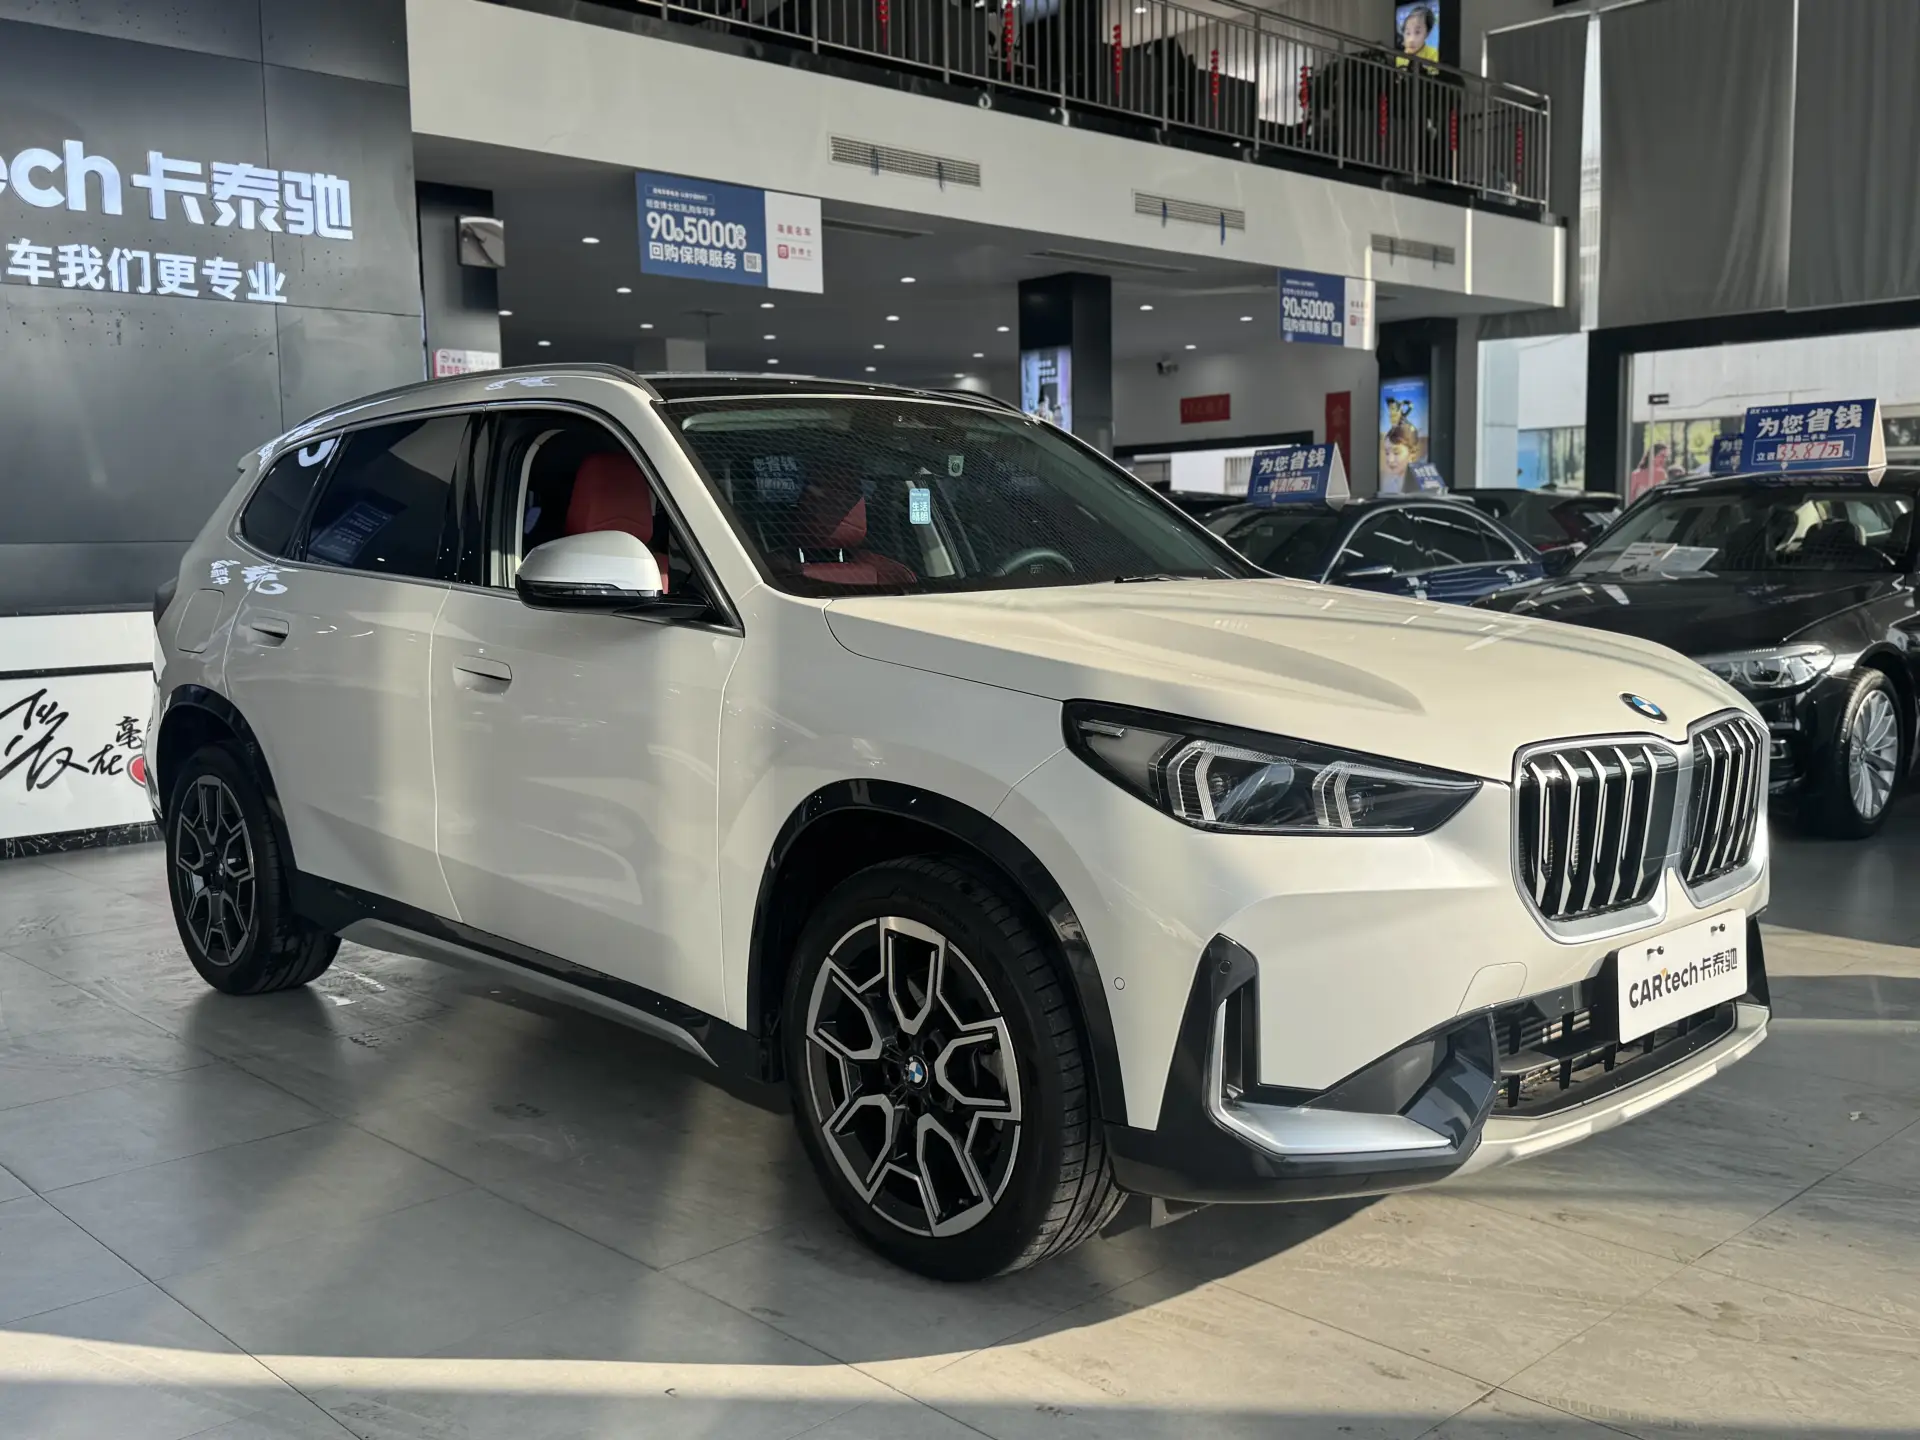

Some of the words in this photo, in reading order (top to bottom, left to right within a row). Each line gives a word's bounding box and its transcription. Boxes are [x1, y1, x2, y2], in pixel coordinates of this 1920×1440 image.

[131, 150, 353, 240] 卡泰驰
[6, 238, 287, 304] 车我们更专业
[649, 241, 737, 270] 回购保障服务
[1756, 404, 1863, 438] 为您省钱
[1258, 447, 1326, 474] 为您省钱
[1629, 961, 1698, 1008] CARtech
[1700, 947, 1738, 981] 卡泰驰
